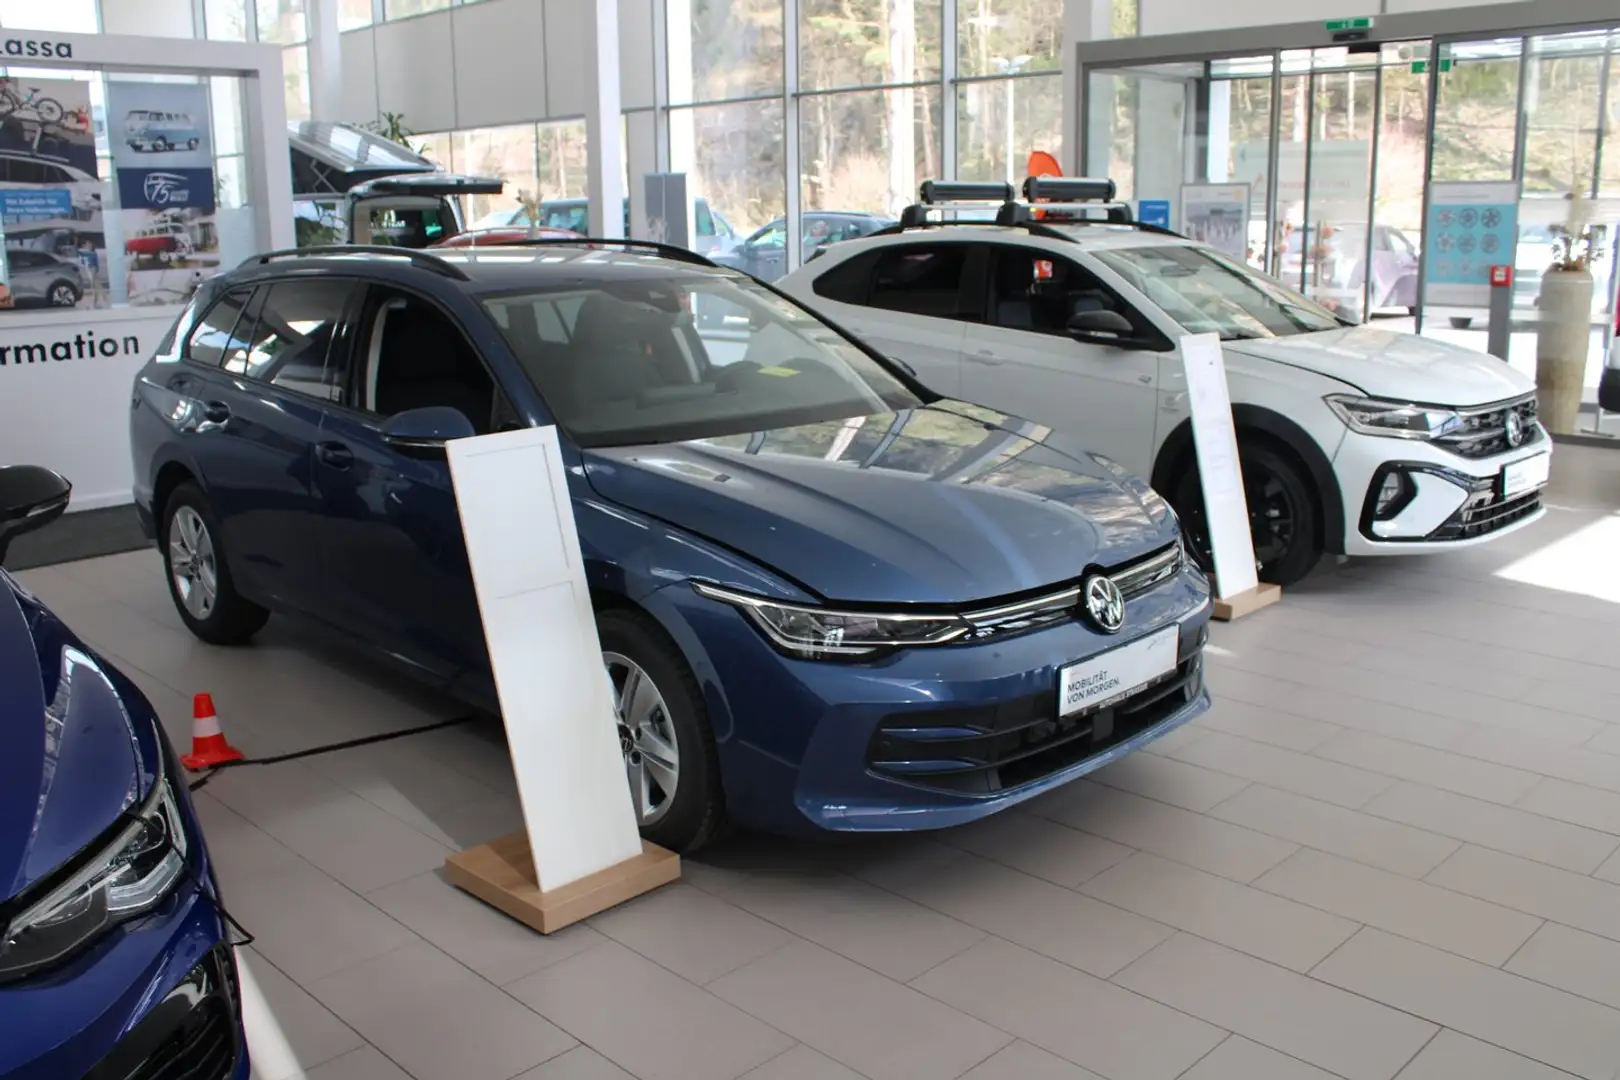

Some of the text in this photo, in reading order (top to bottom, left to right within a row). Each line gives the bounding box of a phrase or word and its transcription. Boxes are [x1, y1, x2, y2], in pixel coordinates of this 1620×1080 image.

[0, 38, 73, 59] assa
[1067, 669, 1108, 693] MOBILITÄT
[1067, 690, 1085, 704] VON
